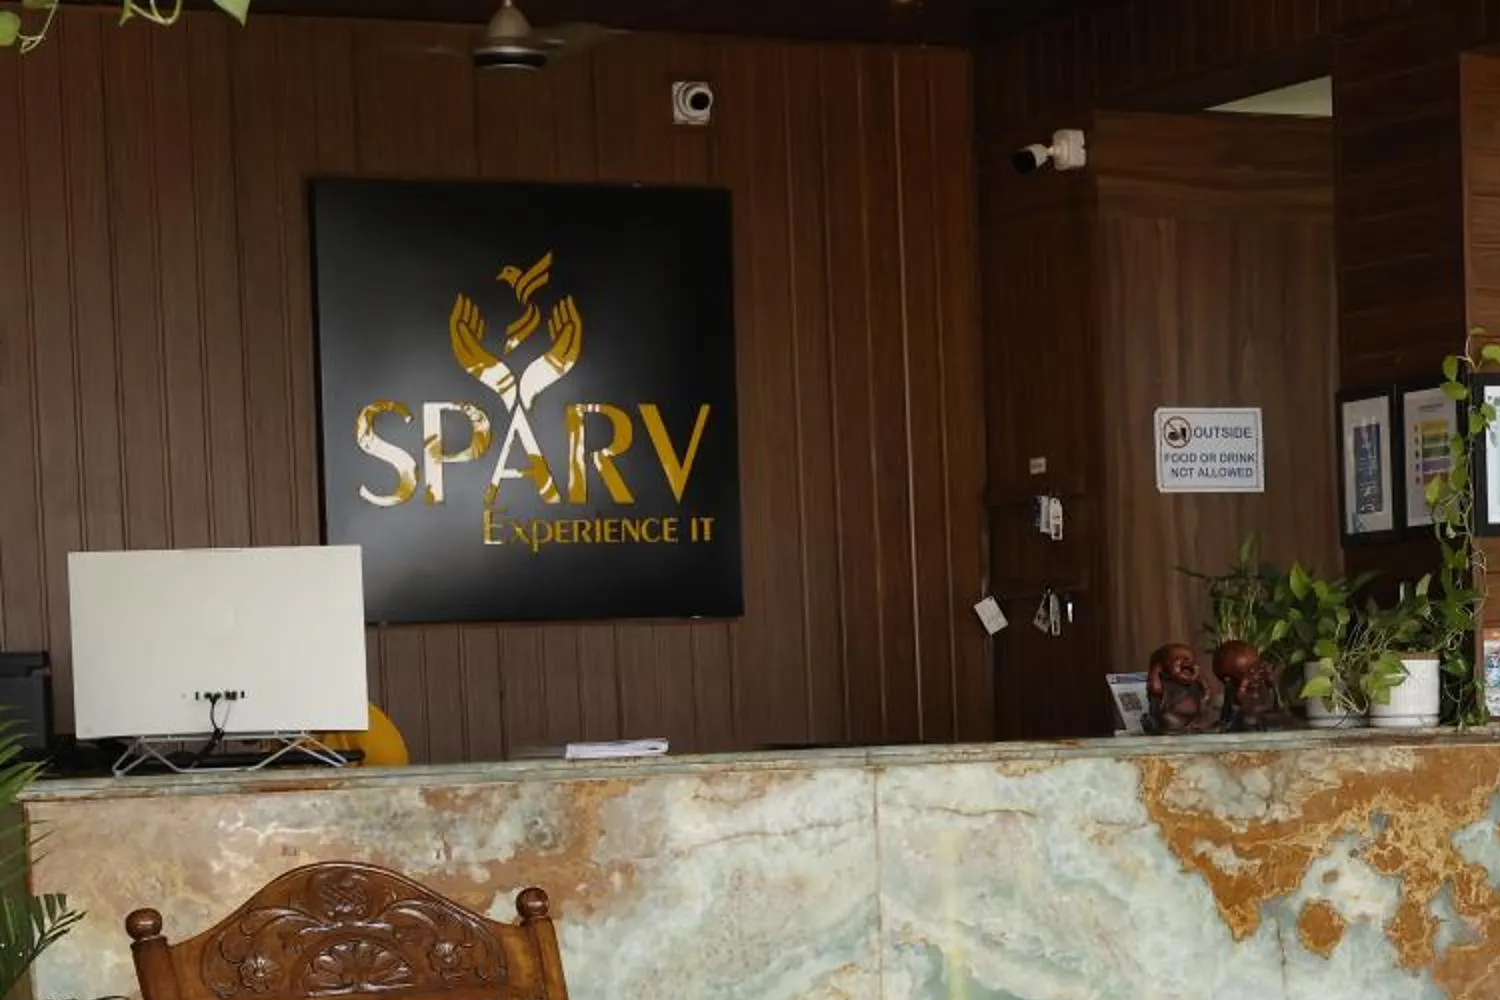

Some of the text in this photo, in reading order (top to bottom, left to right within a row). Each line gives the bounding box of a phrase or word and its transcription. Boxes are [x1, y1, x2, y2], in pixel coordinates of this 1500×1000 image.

[1193, 425, 1253, 439] OUTSIDE
[355, 399, 711, 507] SPARV
[1164, 452, 1255, 464] FOOD OR DRINK
[1171, 467, 1253, 479] NOT ALLOWED
[691, 517, 714, 542] IT
